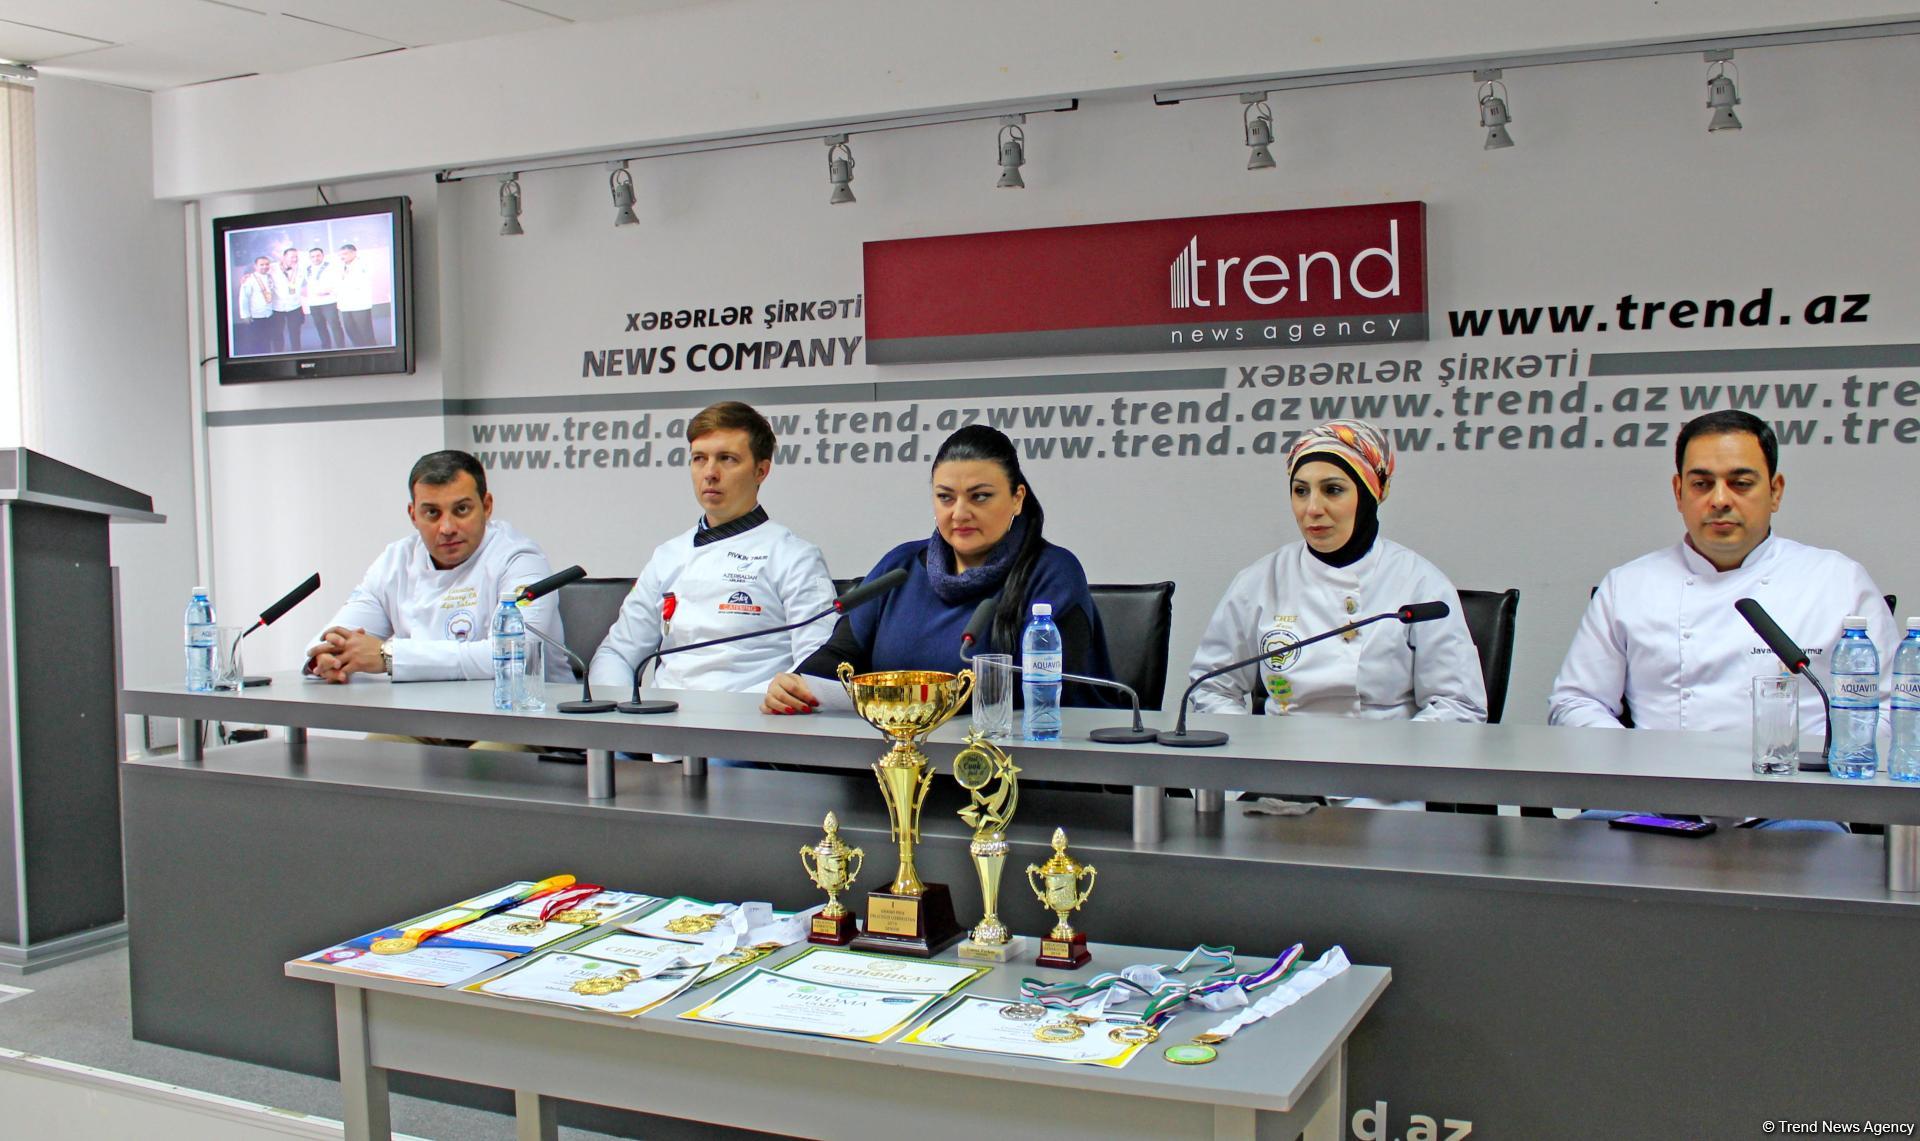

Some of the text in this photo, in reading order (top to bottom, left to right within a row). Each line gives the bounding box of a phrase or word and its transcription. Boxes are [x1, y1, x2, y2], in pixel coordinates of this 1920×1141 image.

[1190, 219, 1400, 307] trend
[625, 294, 862, 332] XƏBƏRLƏR ŞİRKƏTİ
[1171, 318, 1400, 343] news agency
[1447, 287, 1871, 338] www.trend.az
[582, 336, 863, 378] NEWS COMPANY
[1237, 348, 1578, 388] XƏBƏRLƏR ŞİRKƏTİ
[472, 413, 691, 444] www.trend.a
[765, 404, 980, 435] w.trend.az
[474, 442, 692, 469] www.trend.a
[1012, 426, 1301, 459] ww.trend.az
[1390, 416, 1669, 451] w.trend.az
